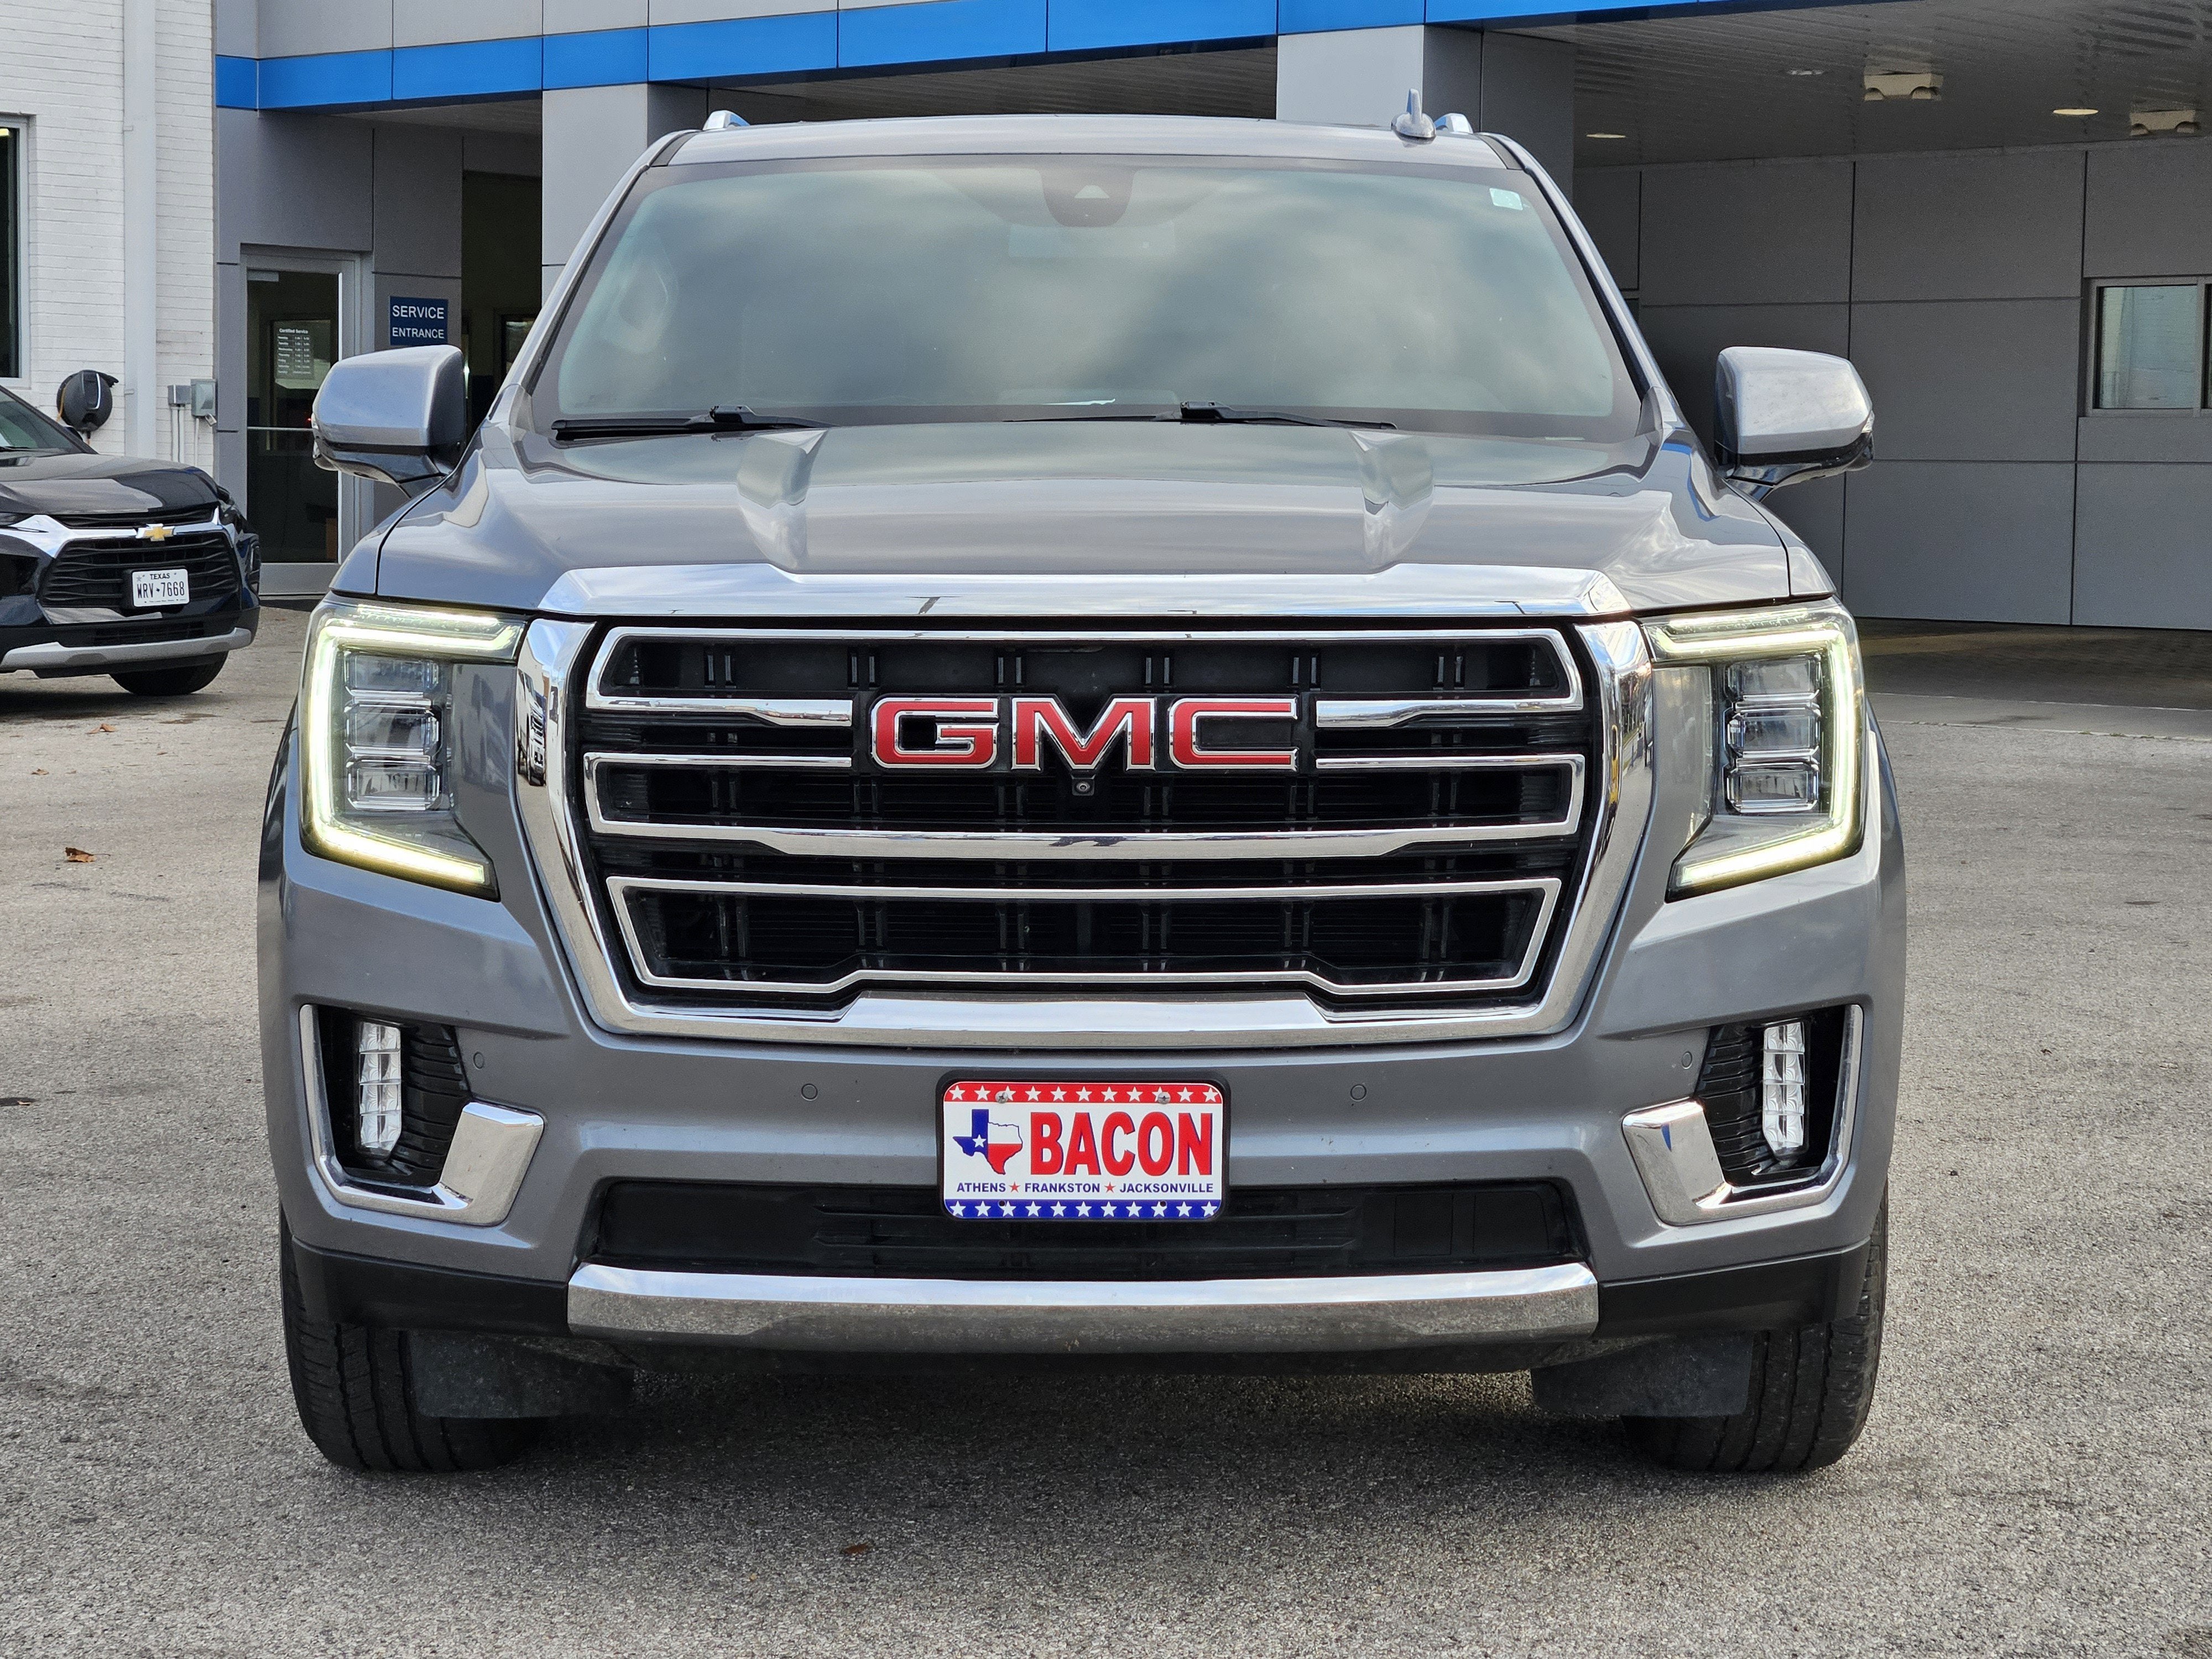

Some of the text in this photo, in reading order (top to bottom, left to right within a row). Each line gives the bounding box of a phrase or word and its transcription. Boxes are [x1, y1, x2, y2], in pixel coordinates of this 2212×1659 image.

[392, 305, 445, 319] SERVICE
[392, 327, 445, 339] ENTRANCE
[160, 581, 185, 597] 7668
[872, 697, 1297, 771] GMC
[1030, 1111, 1213, 1176] BACON
[956, 1182, 1214, 1193] ATHENS FRANKSTON JACKSONVILLE
